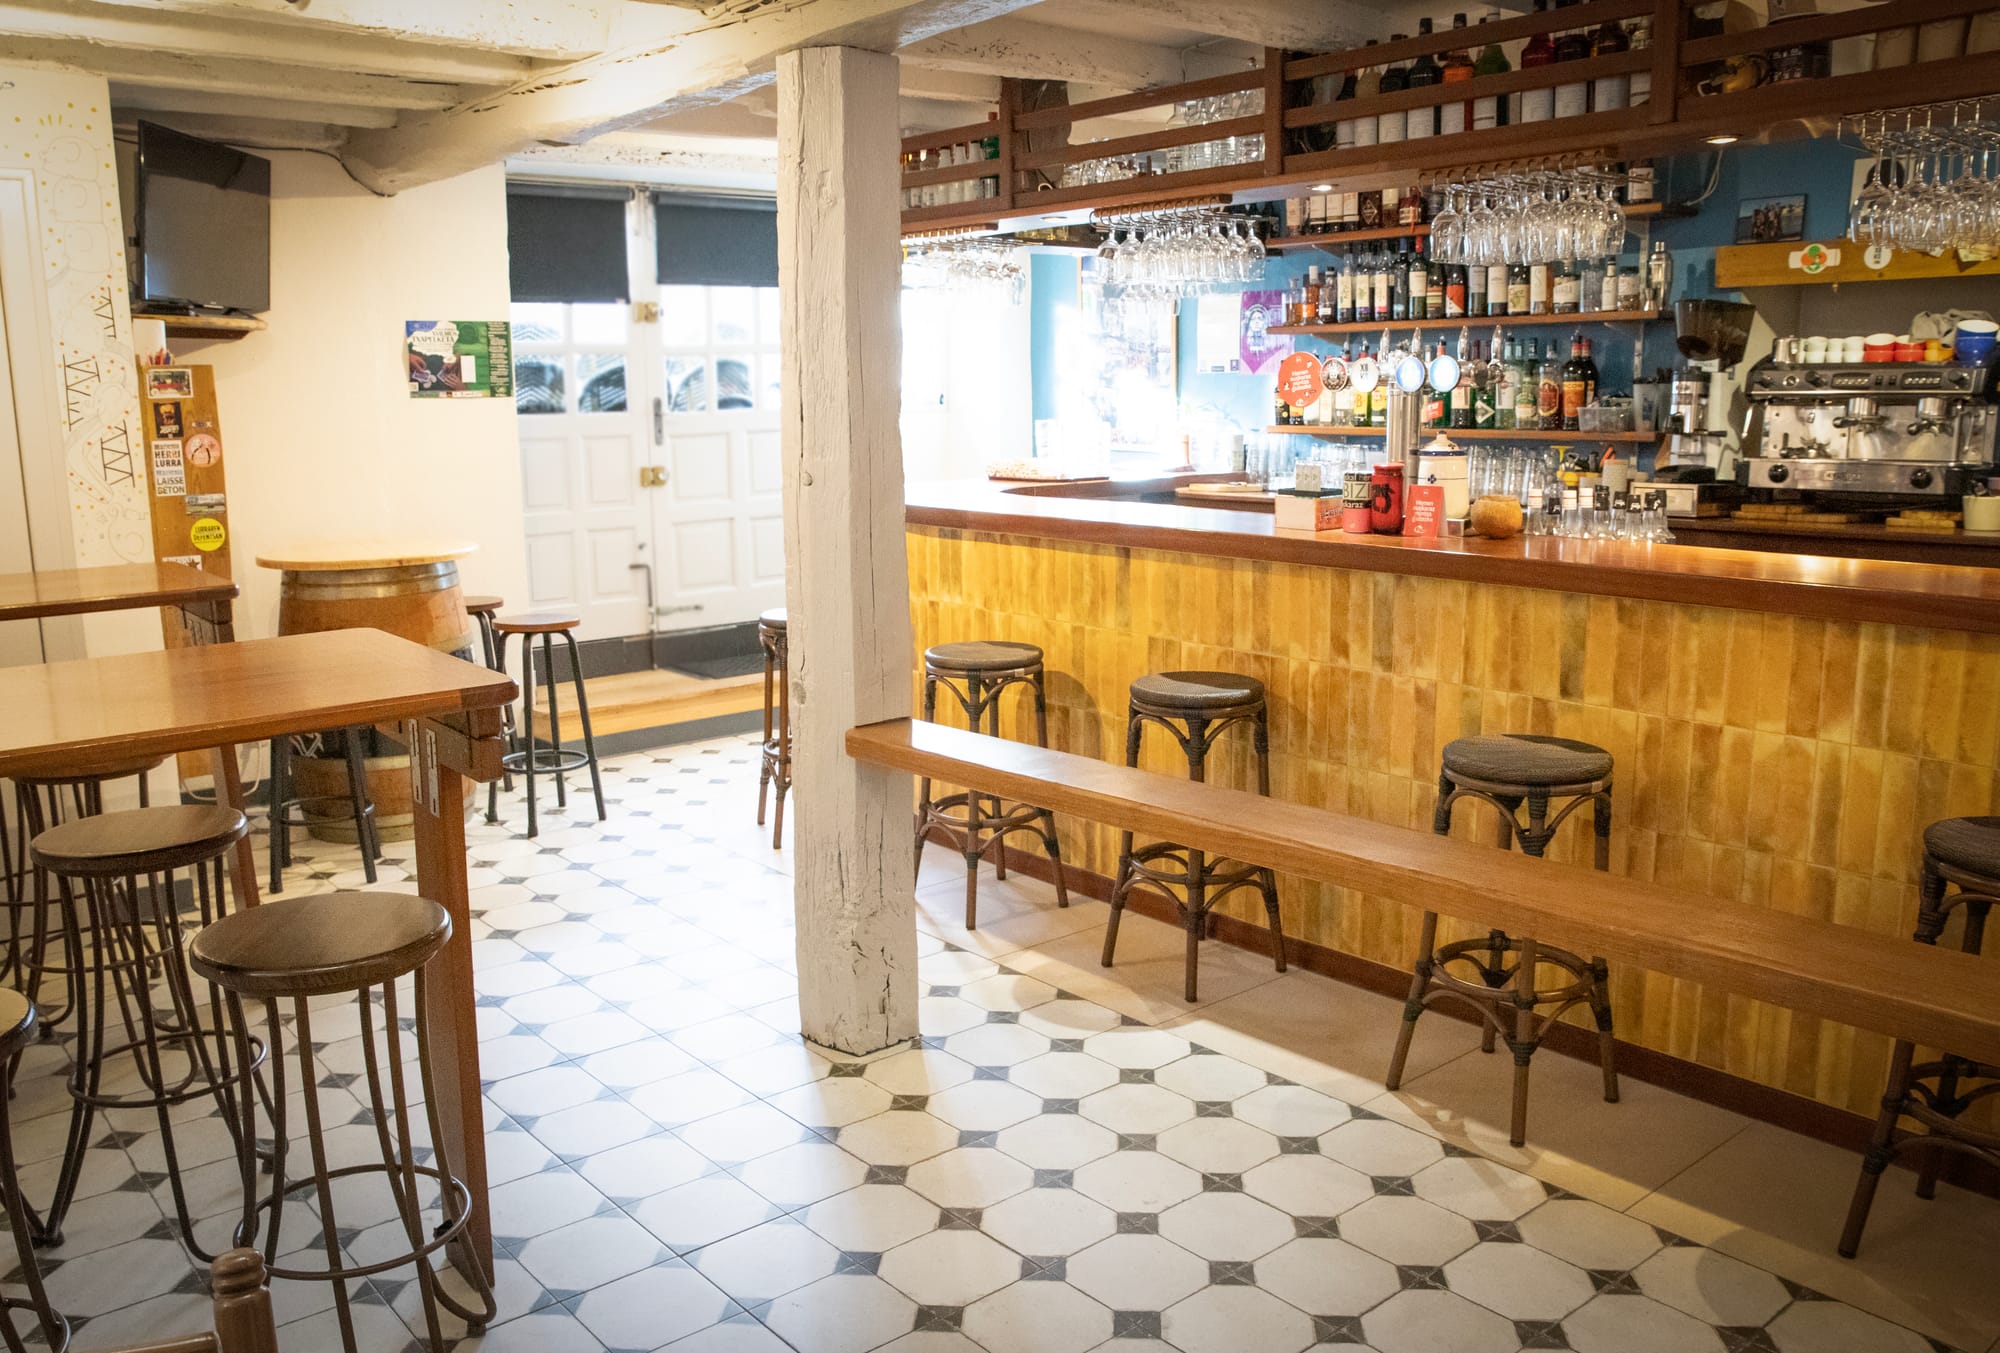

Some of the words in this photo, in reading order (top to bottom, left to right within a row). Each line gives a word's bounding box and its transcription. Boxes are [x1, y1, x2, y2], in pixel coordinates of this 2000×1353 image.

[154, 450, 181, 459] HERRI
[155, 459, 182, 467] LURRA
[157, 477, 184, 486] LAISSE
